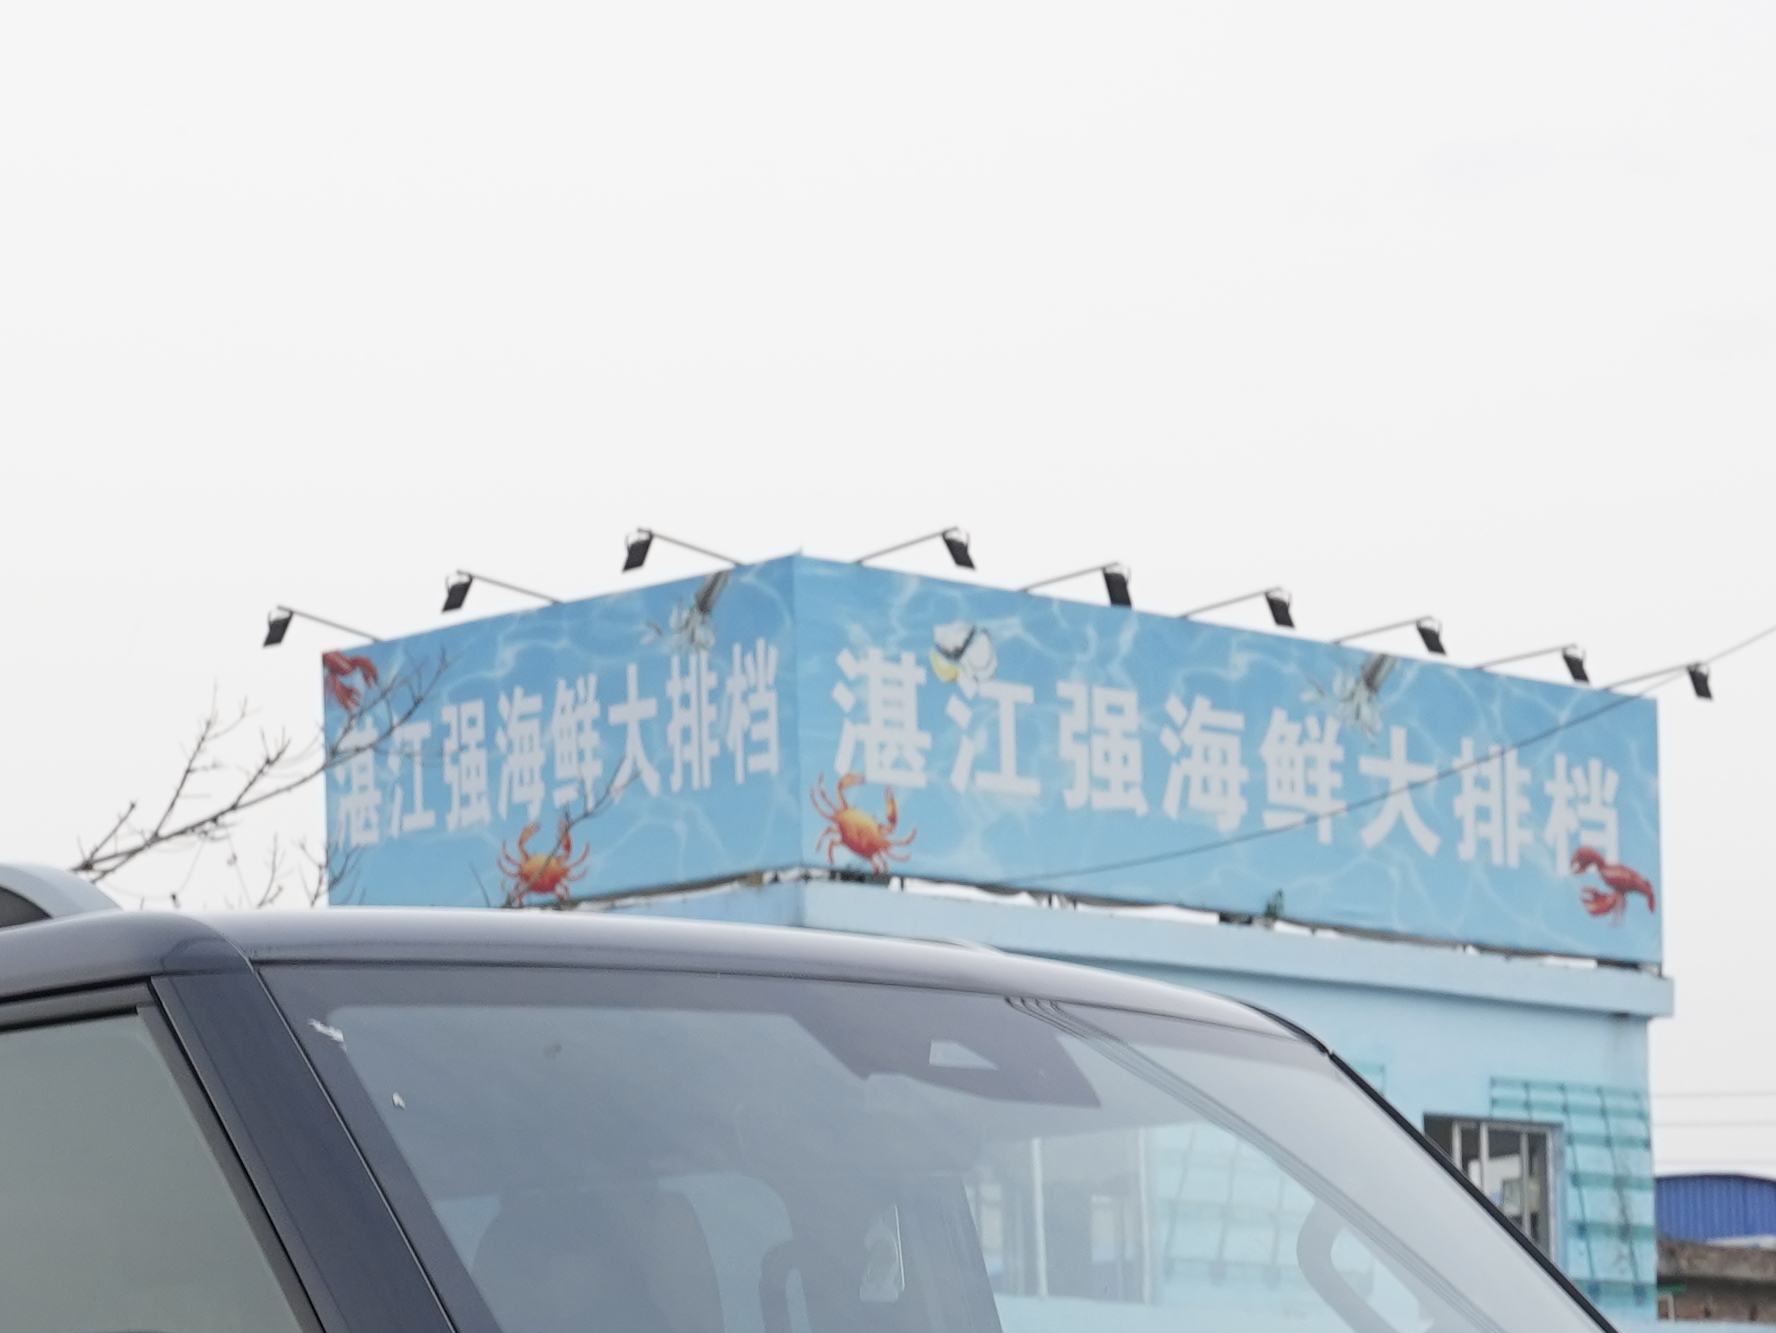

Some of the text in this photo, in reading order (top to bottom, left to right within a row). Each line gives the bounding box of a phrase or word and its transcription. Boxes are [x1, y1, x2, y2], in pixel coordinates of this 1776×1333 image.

[334, 637, 780, 848] 湛江强海鲜大排档
[830, 647, 1620, 878] 湛江强海鲜大排档
